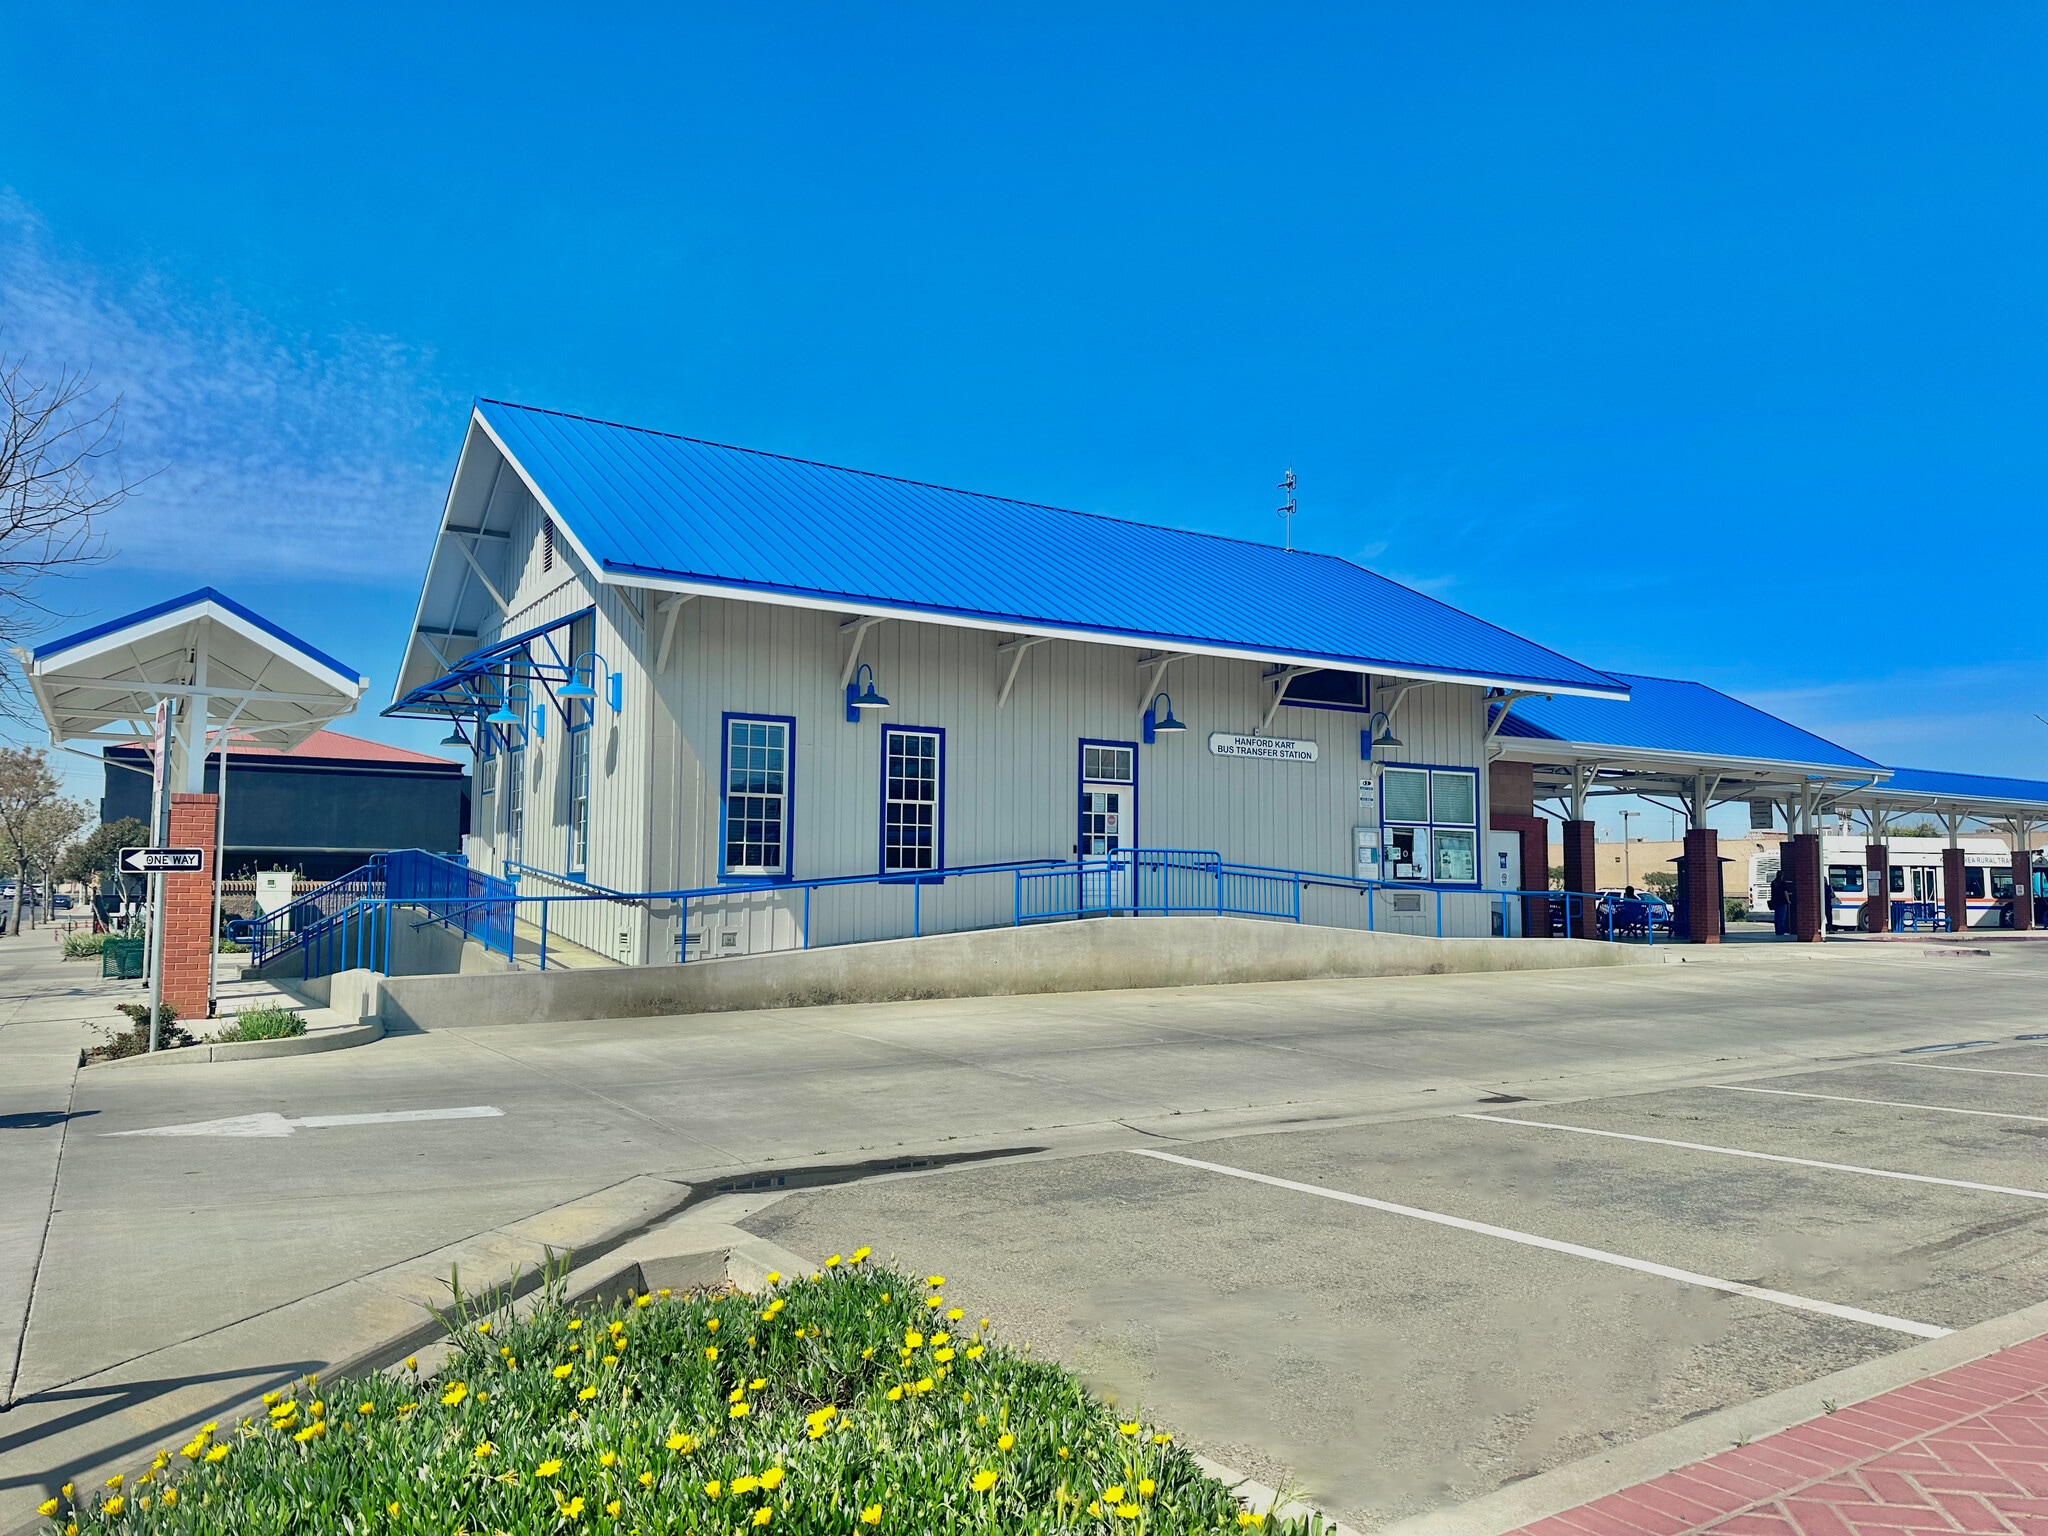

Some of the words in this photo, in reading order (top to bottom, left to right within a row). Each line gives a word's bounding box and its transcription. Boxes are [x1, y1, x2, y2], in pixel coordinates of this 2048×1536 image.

[1234, 737, 1274, 748] HANFORD
[1275, 740, 1296, 749] KART
[1217, 744, 1235, 754] BUS
[1236, 746, 1278, 757] TRANSFER
[1279, 750, 1312, 760] STATION
[146, 855, 169, 865] ONE
[172, 855, 196, 865] WAY
[1977, 857, 1997, 865] RURAL
